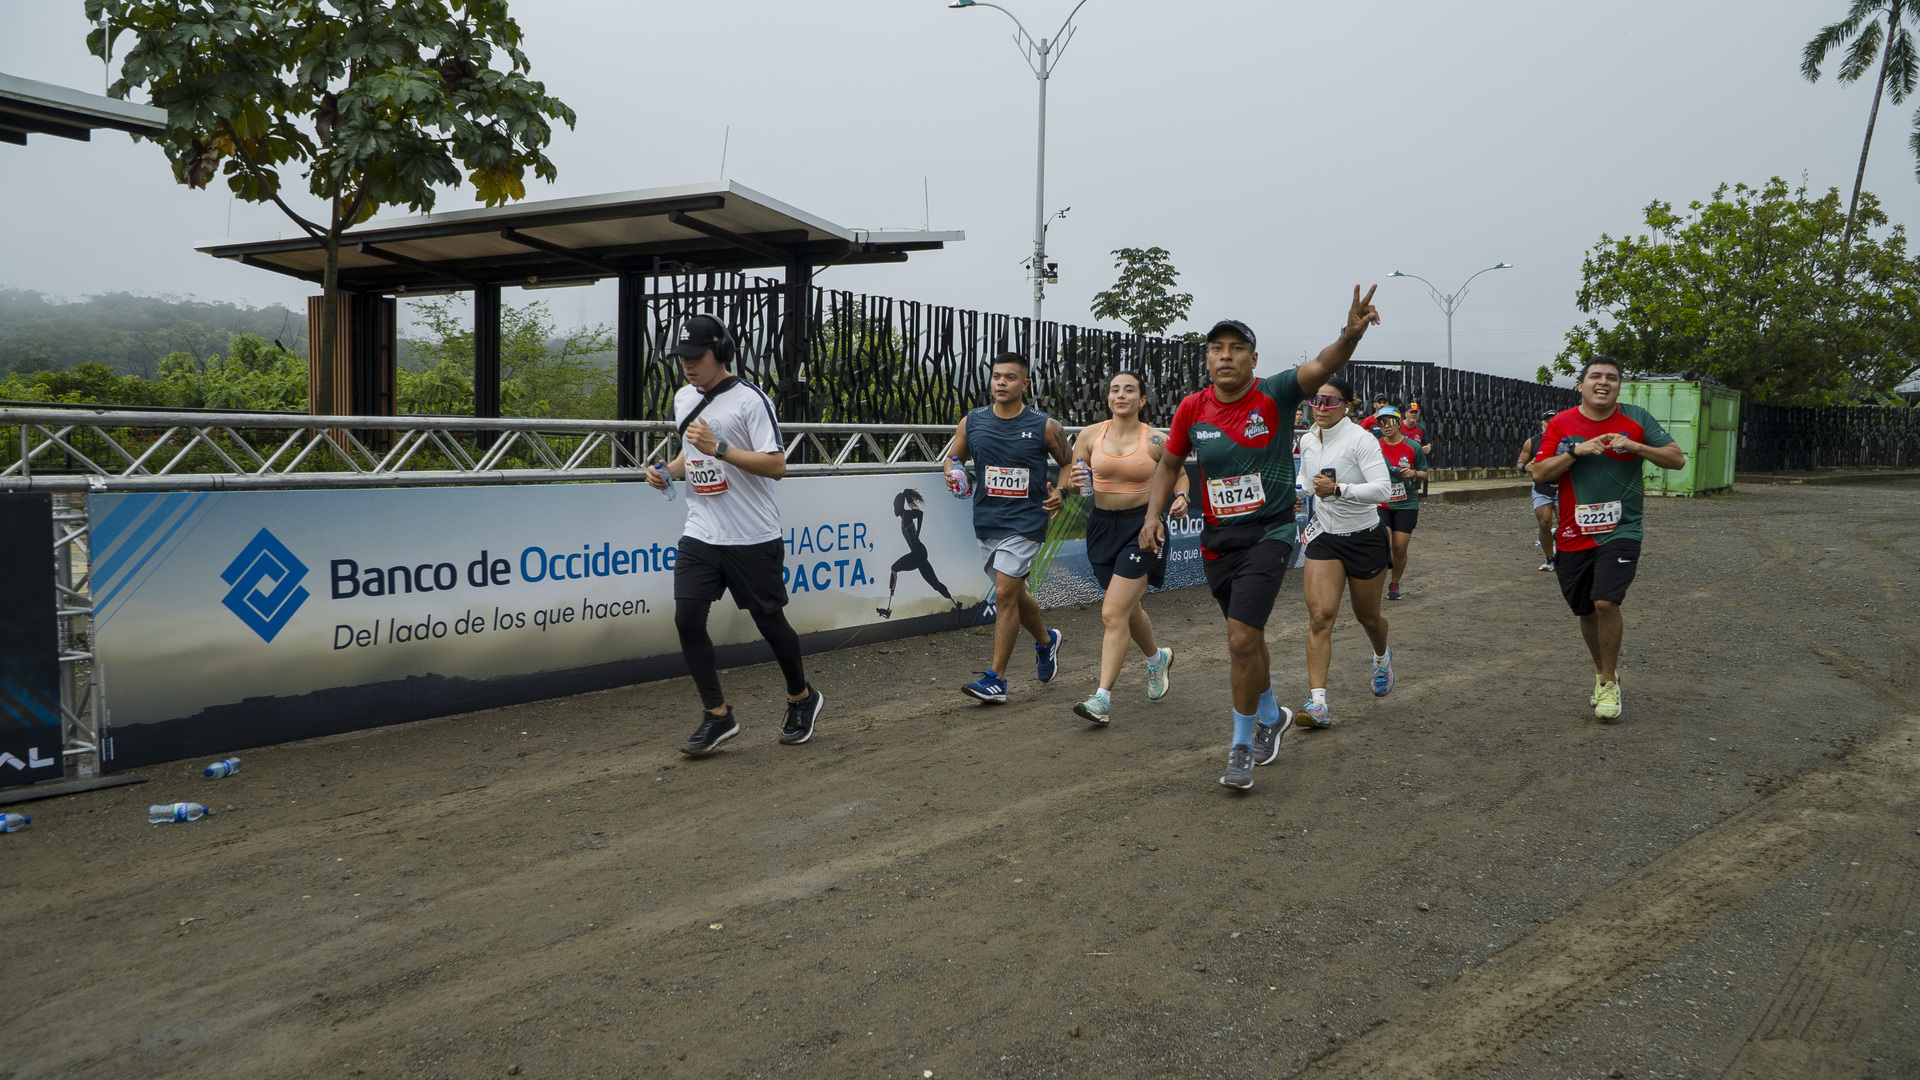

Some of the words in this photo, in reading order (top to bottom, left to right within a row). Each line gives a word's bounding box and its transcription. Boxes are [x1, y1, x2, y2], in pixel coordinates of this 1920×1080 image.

[690, 469, 717, 484] 2002
[992, 475, 1020, 489] 1701
[1218, 486, 1255, 505] 1874
[1582, 511, 1614, 525] 2221
[1183, 548, 1199, 563] que
[330, 558, 457, 600] Banco
[467, 549, 511, 588] de
[519, 542, 678, 584] Occidente
[333, 619, 380, 650] Del
[389, 613, 448, 644] lado
[454, 609, 486, 636] de
[493, 606, 526, 632] los
[533, 603, 575, 631] que
[582, 598, 651, 621] hacen.
